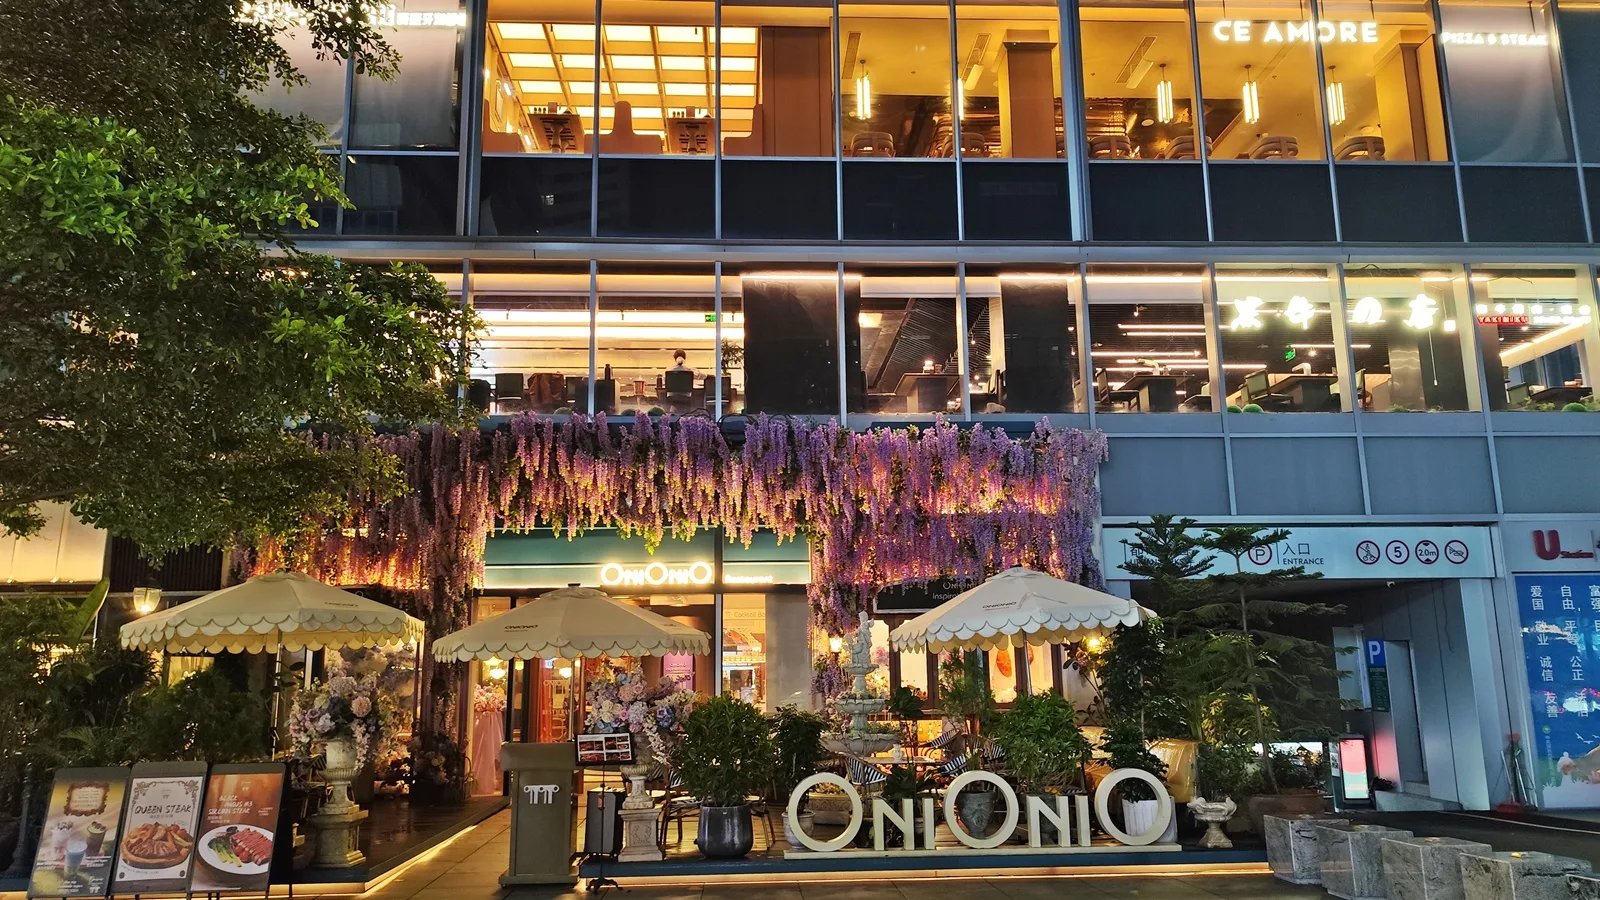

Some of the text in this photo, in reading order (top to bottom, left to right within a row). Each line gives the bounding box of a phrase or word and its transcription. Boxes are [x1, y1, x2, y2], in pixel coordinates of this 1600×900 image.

[1264, 21, 1379, 43] AMORE
[1441, 32, 1484, 44] PIZZA
[1500, 34, 1547, 45] STEAK
[1478, 316, 1529, 324] YAKINIKU
[1282, 542, 1311, 556] 入口
[1533, 529, 1561, 560] U
[1394, 546, 1402, 558] 5
[1418, 549, 1437, 557] 2.0m
[1282, 557, 1325, 566] ENTRANCE
[1560, 585, 1575, 610] 自由
[1570, 655, 1584, 681] 公正
[1368, 640, 1381, 665] P
[1530, 585, 1559, 718] 爱国 敬业 诚信 友善
[135, 805, 192, 815] QUEEN STEAK
[787, 768, 1172, 852] ONIONIO
